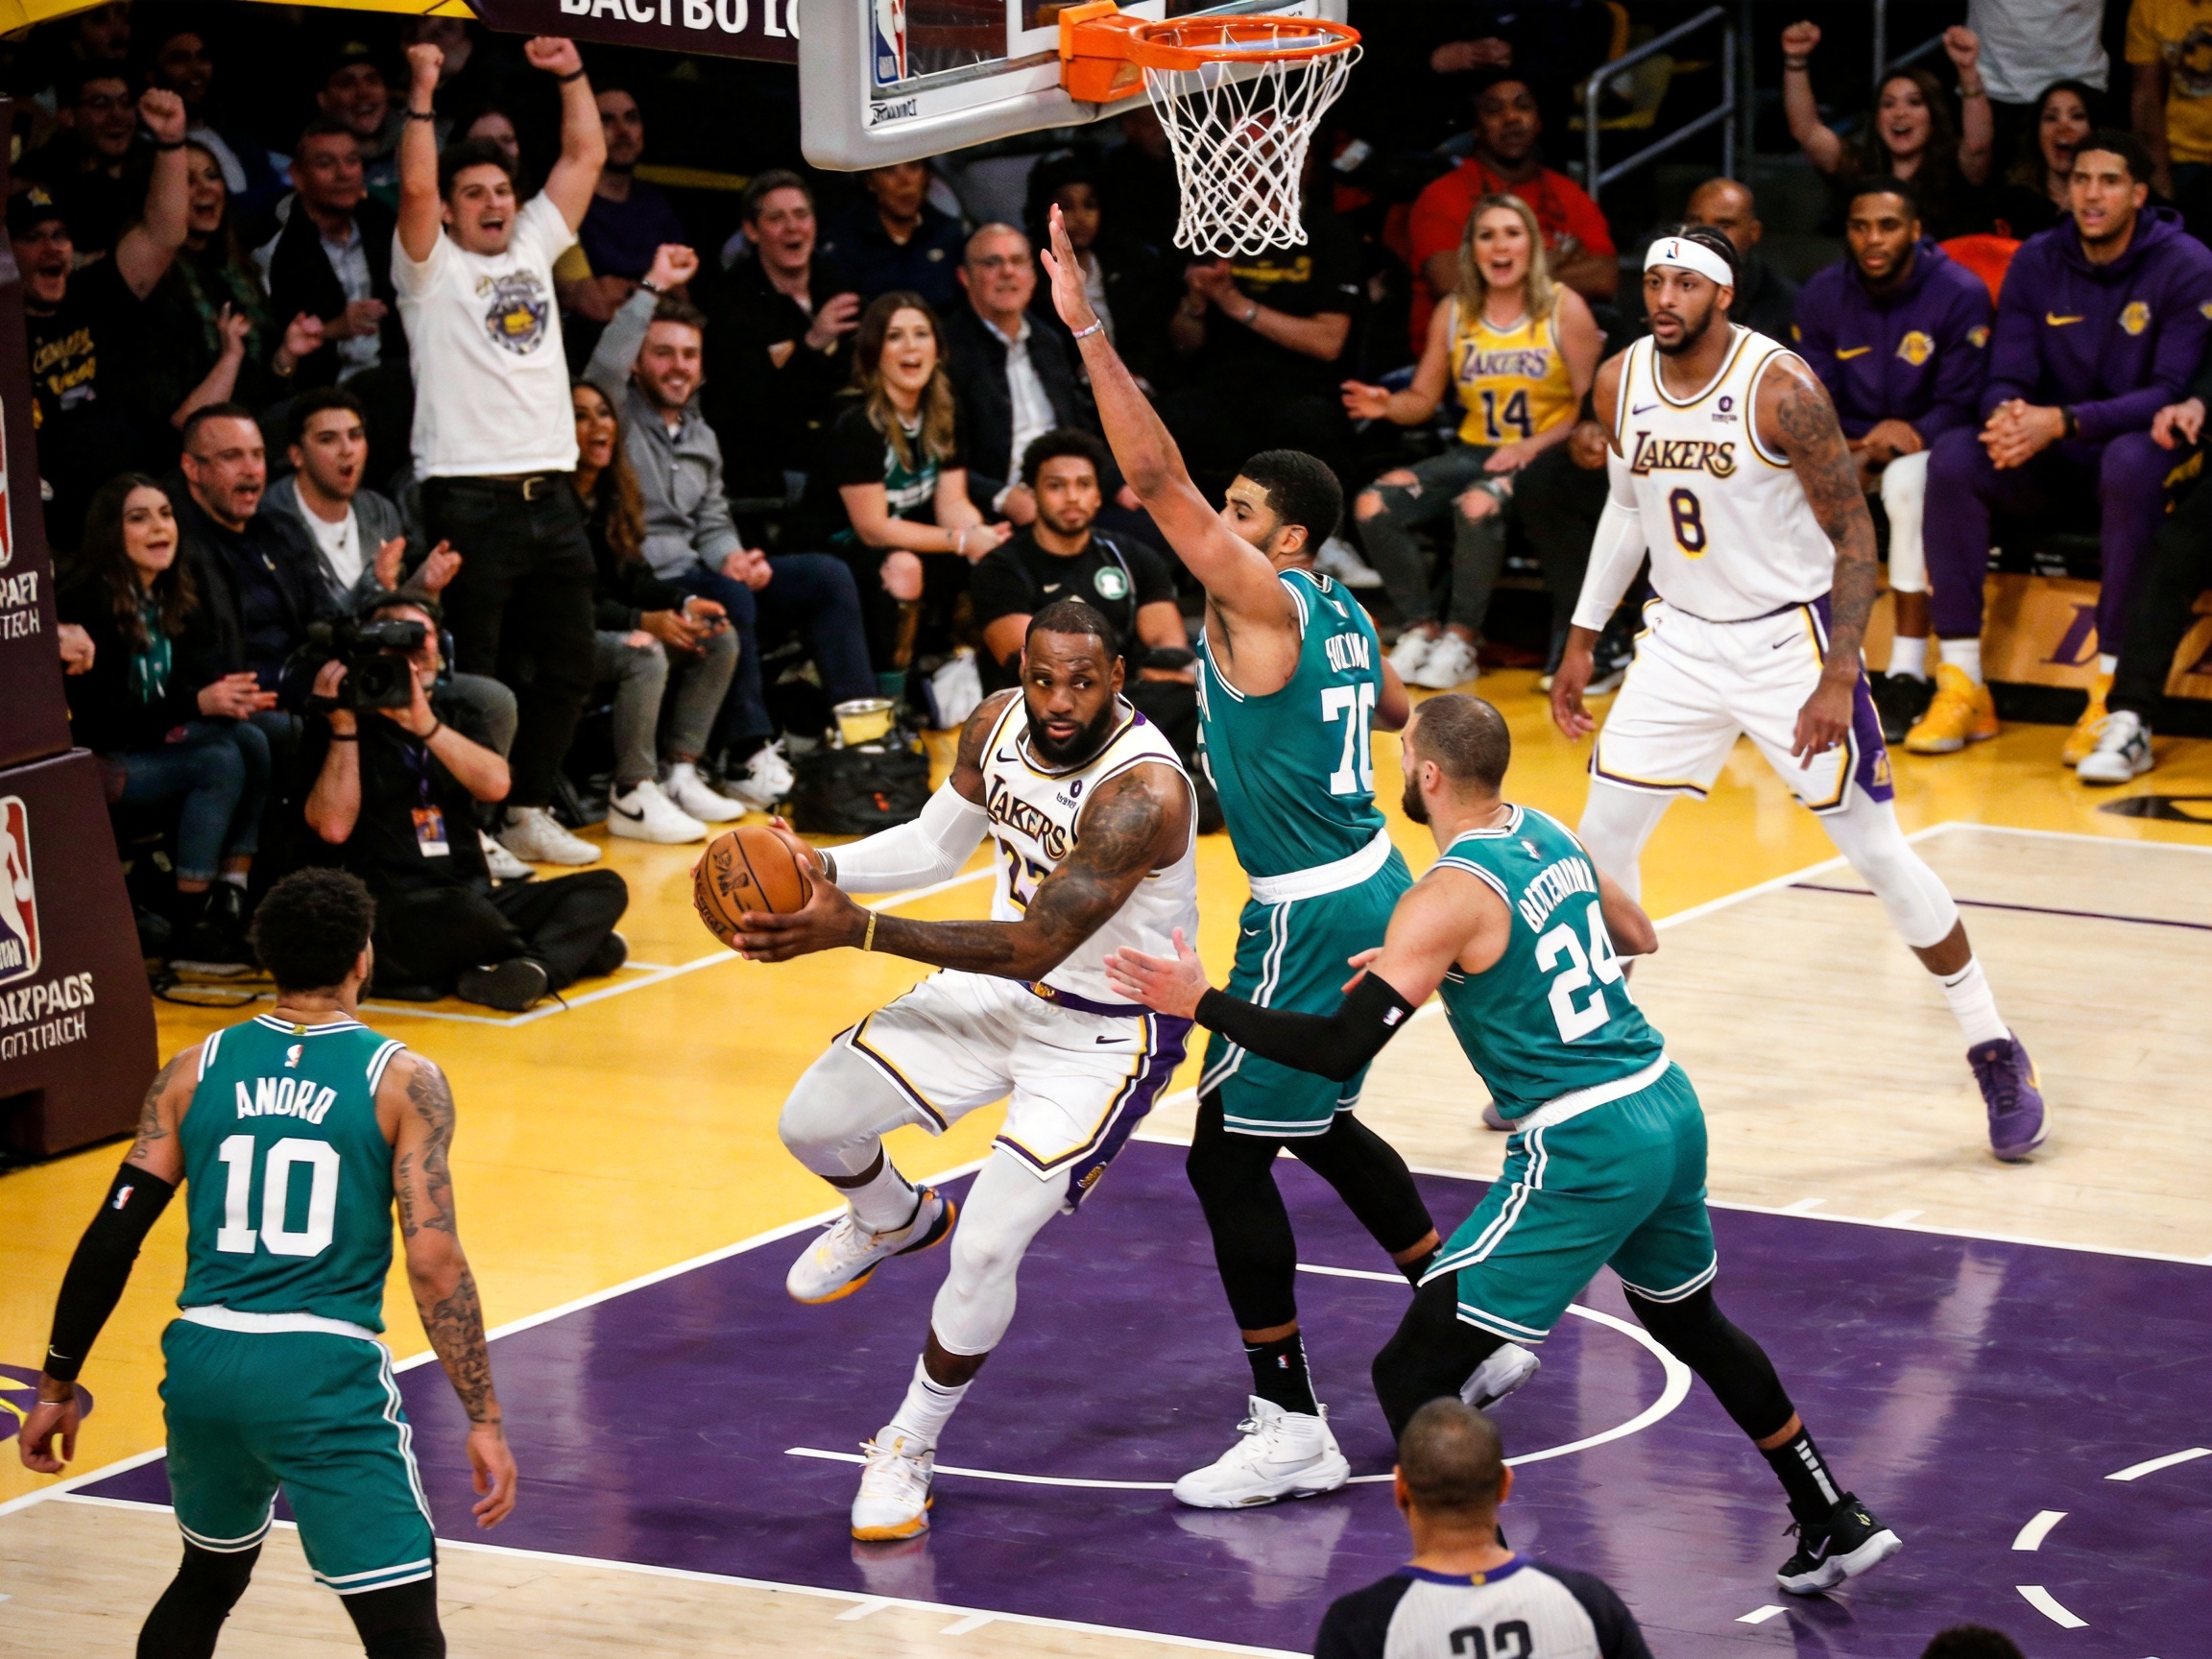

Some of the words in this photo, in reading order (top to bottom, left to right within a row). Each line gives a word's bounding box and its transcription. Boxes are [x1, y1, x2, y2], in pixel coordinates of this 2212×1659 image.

[1480, 390, 1533, 439] 14
[1629, 430, 1740, 480] LAKERS
[1669, 487, 1708, 555] 8
[987, 774, 1068, 861] LAKERS
[1535, 900, 1623, 1045] 24
[217, 1134, 341, 1258] 10
